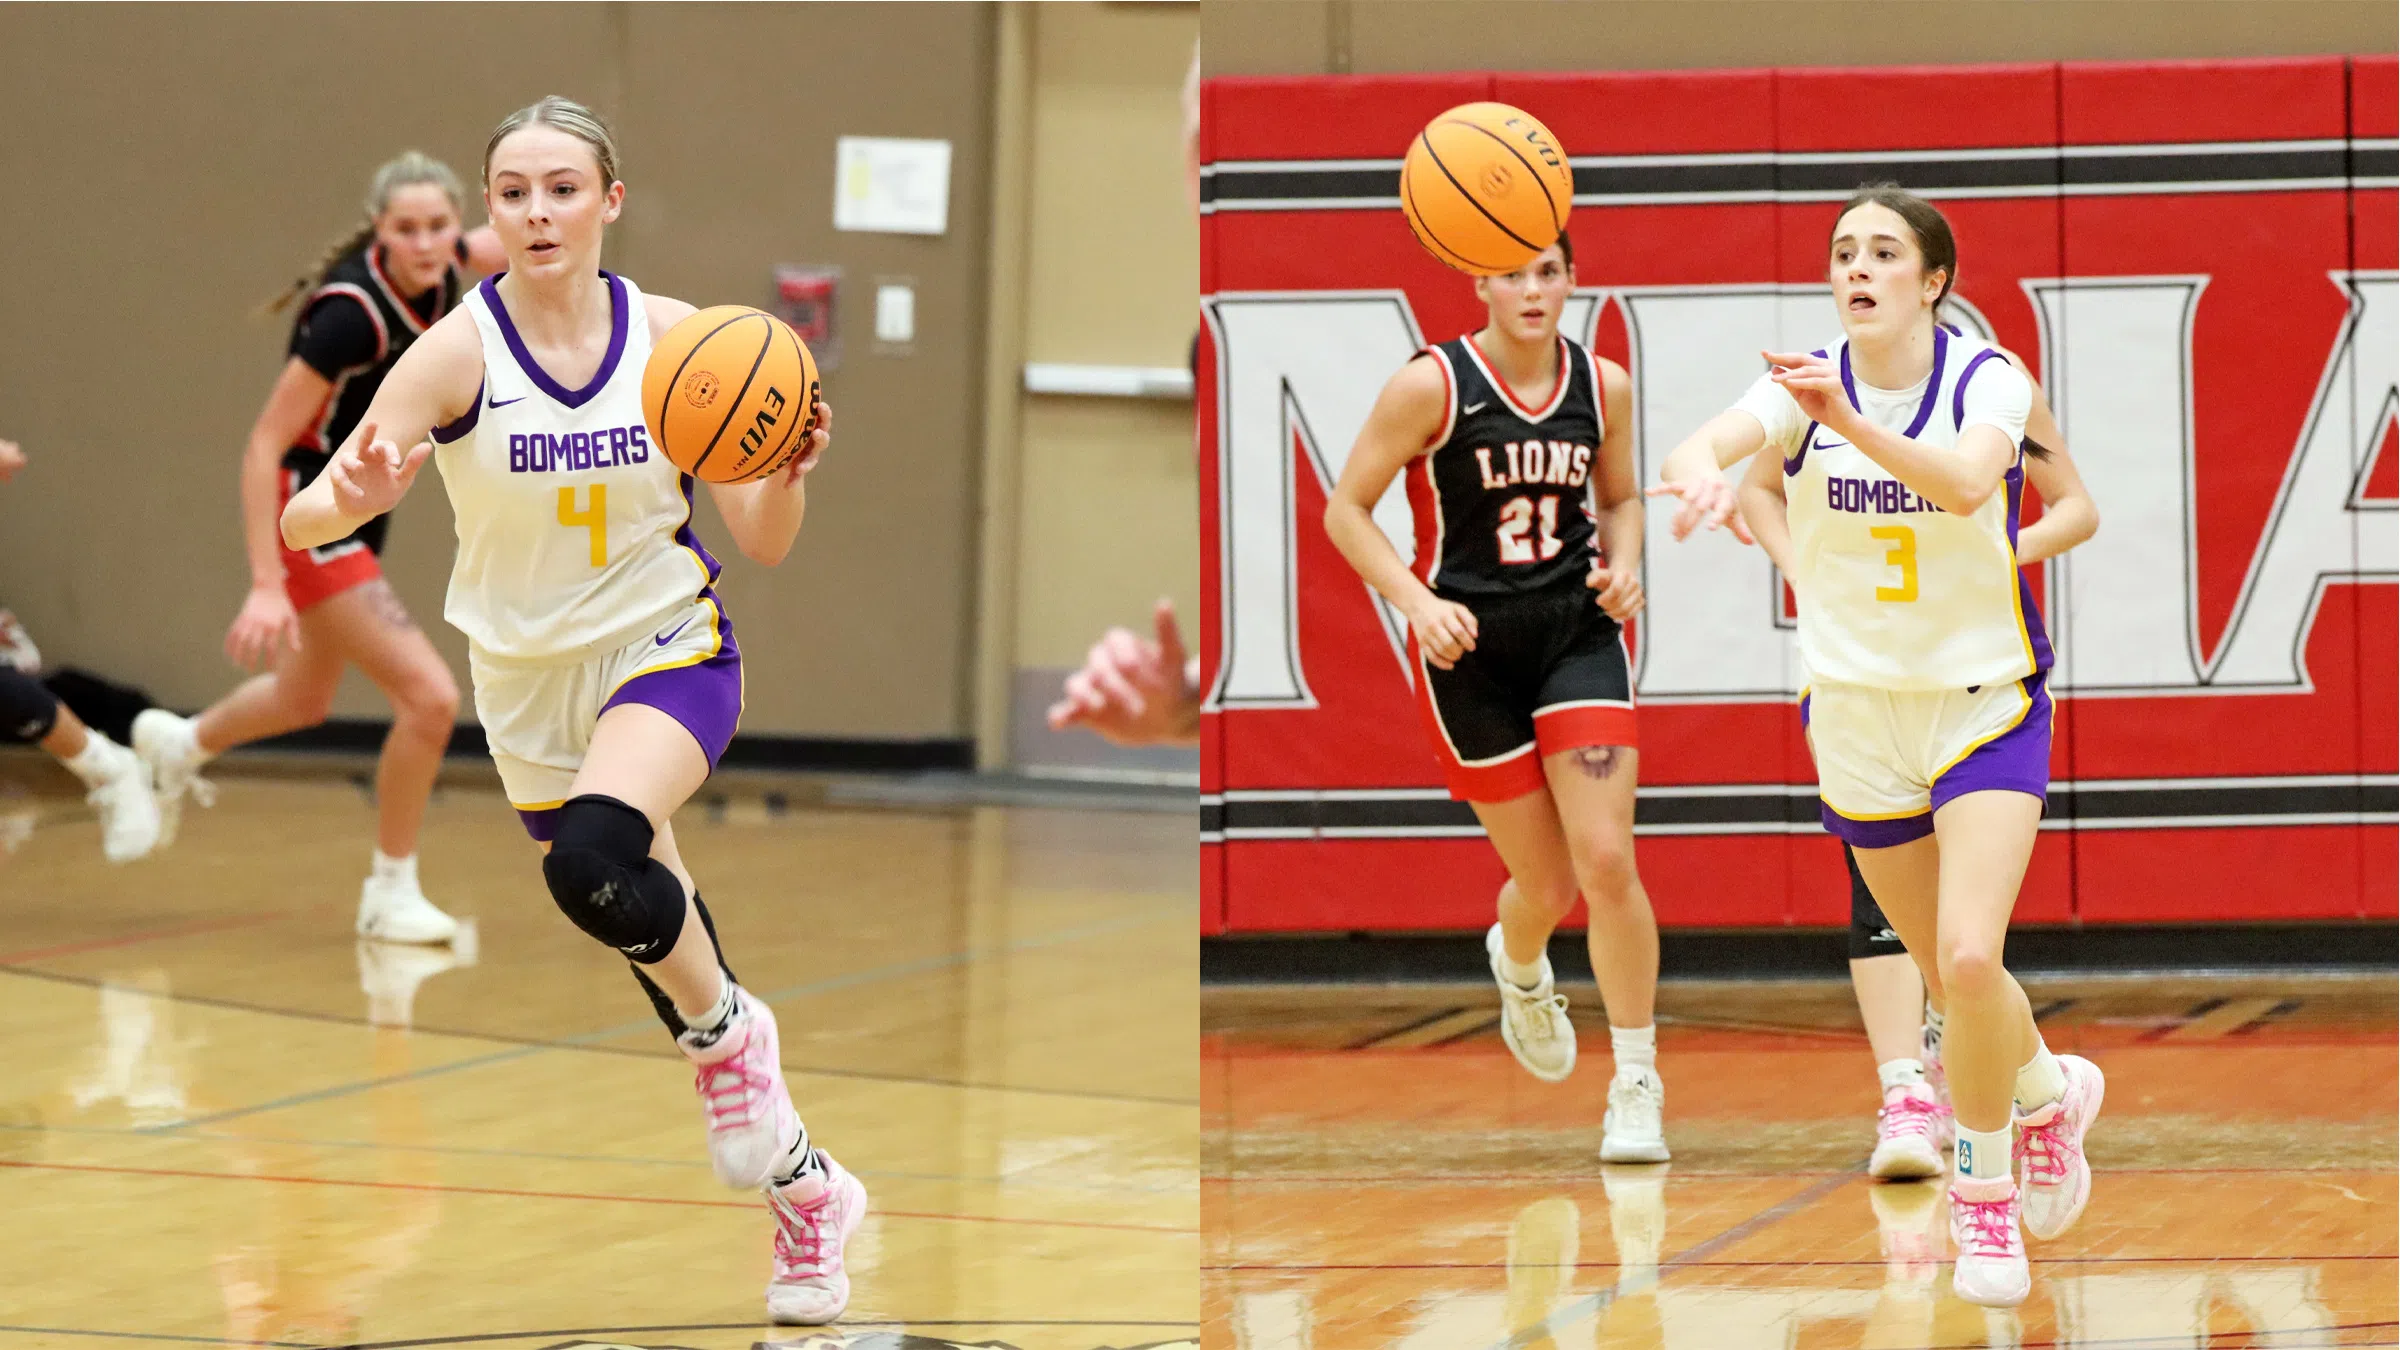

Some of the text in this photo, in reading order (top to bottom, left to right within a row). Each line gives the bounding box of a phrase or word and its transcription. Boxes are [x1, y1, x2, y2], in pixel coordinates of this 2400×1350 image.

[509, 425, 649, 473] BOMBERS
[739, 386, 786, 457] EVO
[1475, 440, 1591, 490] LIONS
[1828, 476, 1948, 513] BOMBE
[557, 483, 607, 568] 4
[1497, 495, 1563, 564] 21
[1869, 525, 1919, 603] 3
